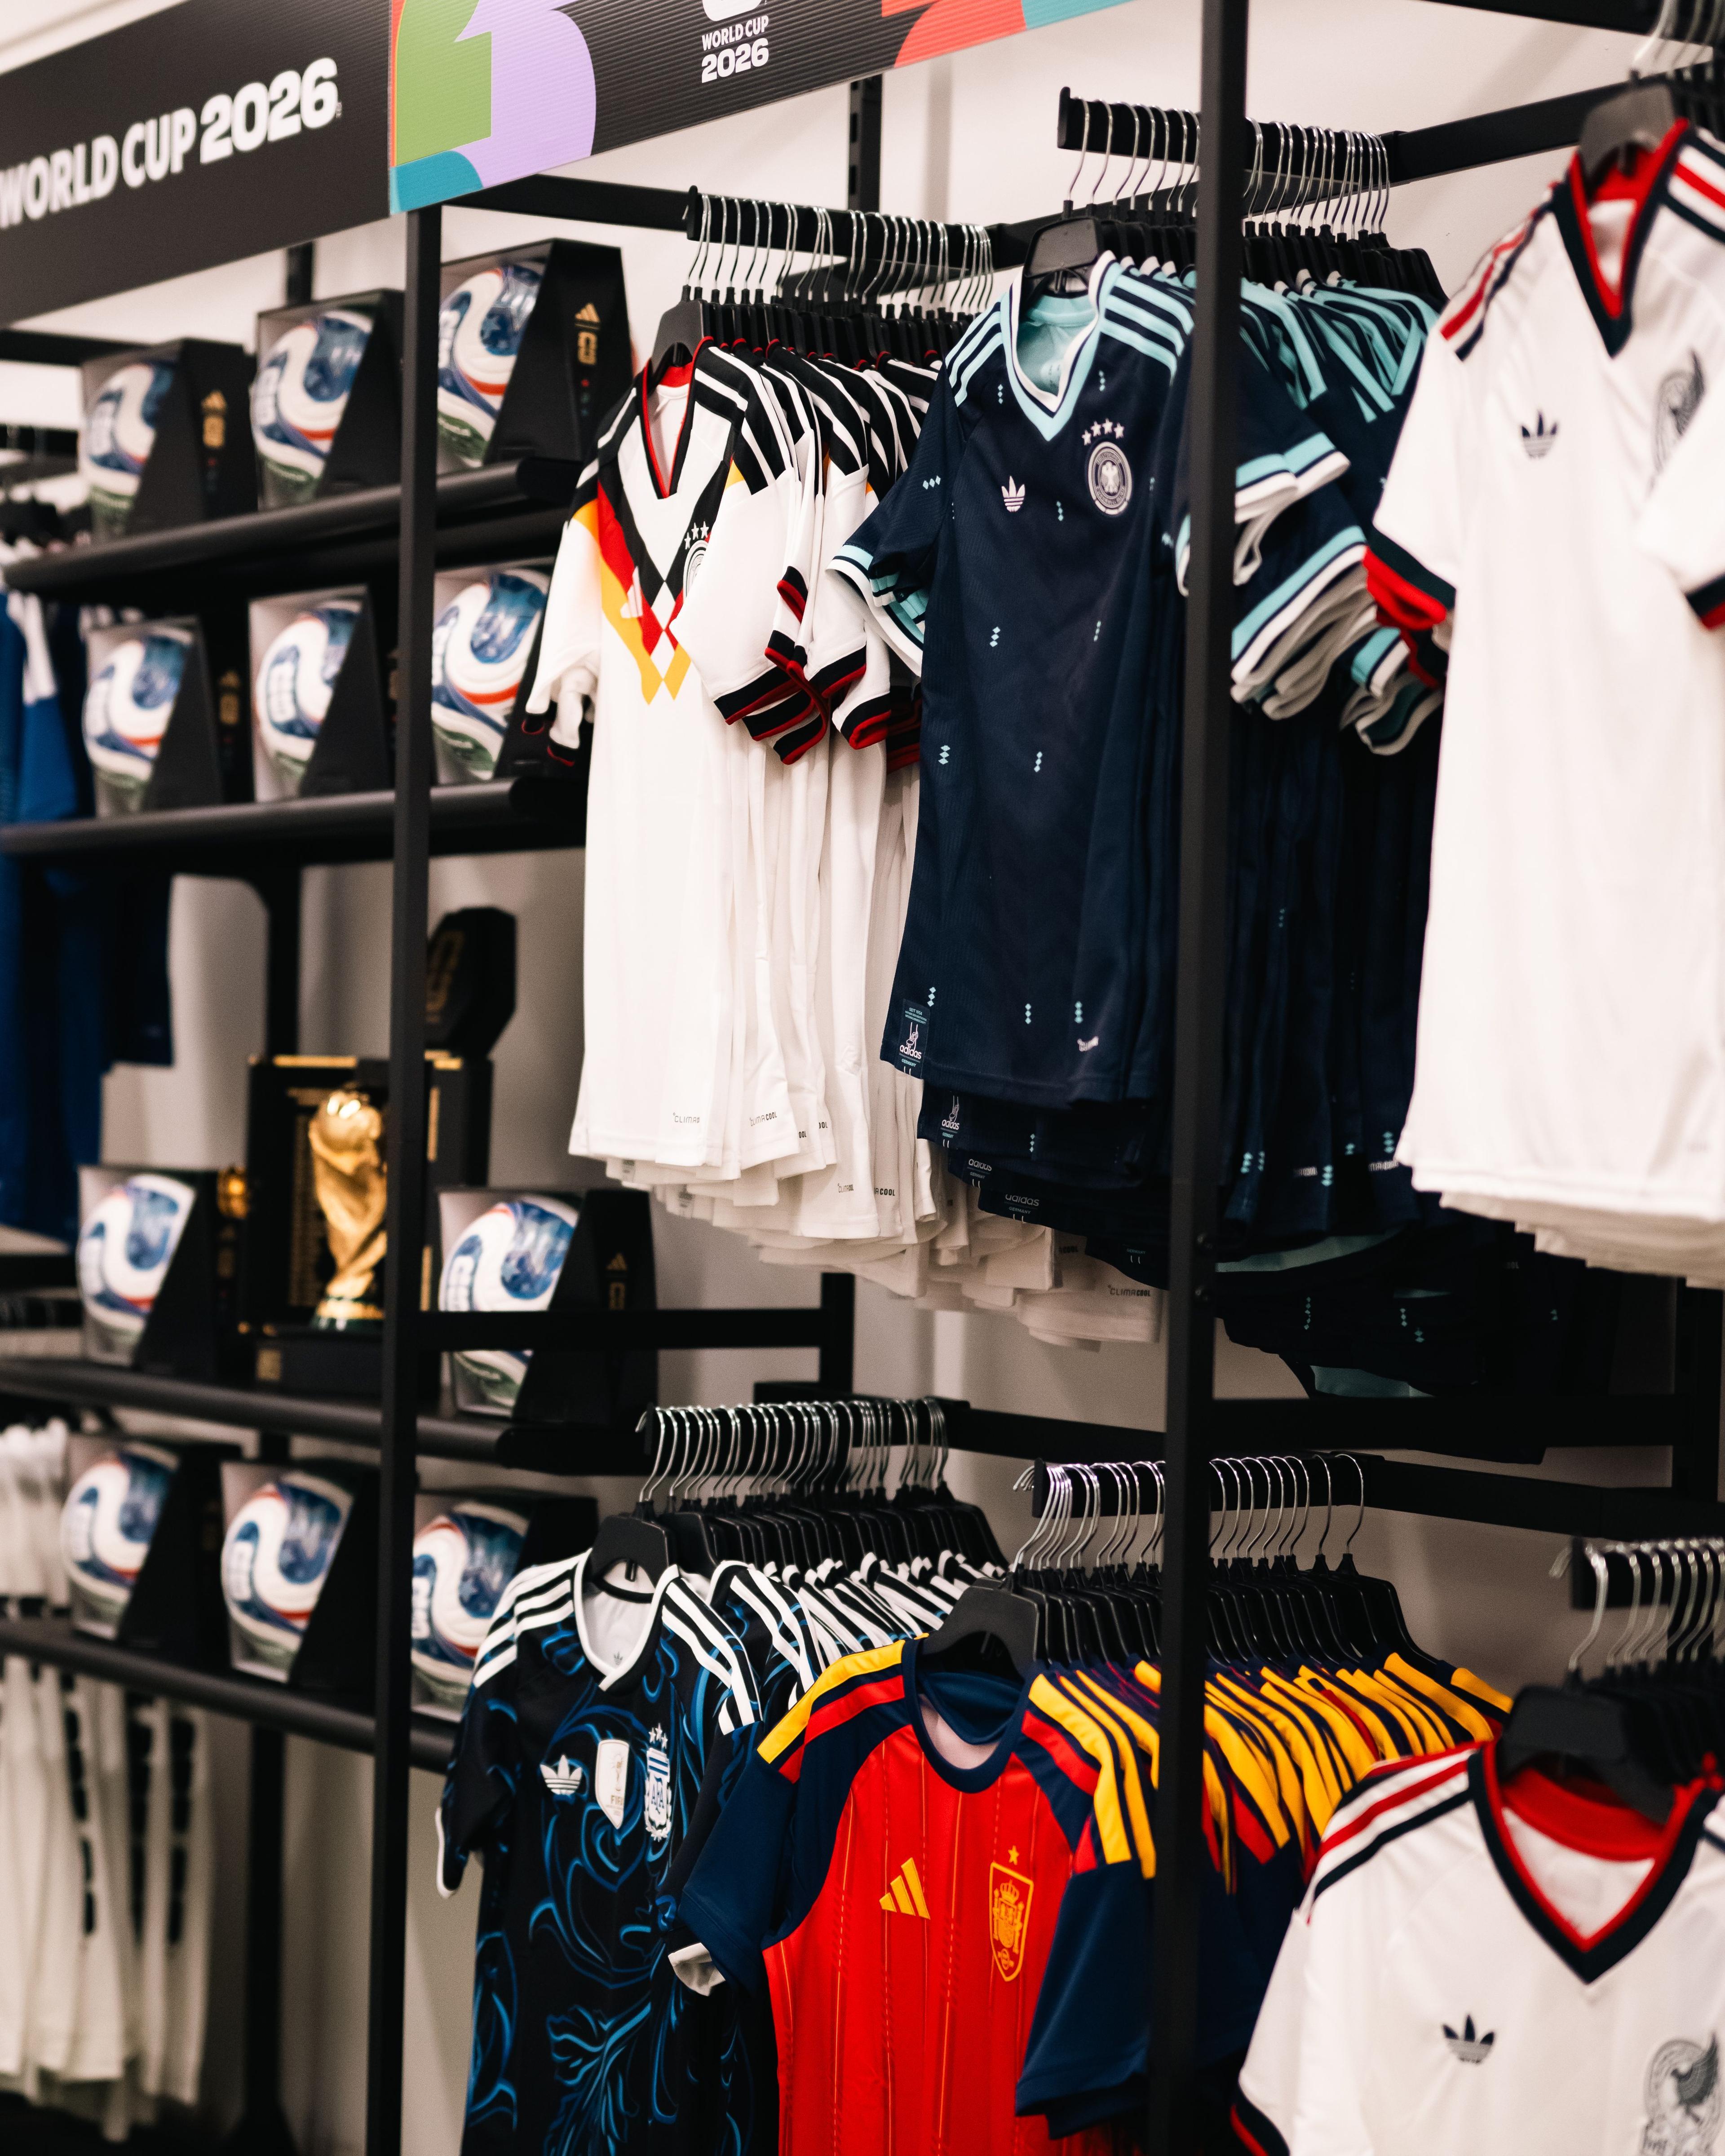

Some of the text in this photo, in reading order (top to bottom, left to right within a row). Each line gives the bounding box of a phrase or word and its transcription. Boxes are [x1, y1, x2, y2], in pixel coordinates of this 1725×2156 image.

[702, 15, 769, 51] WORLD CUP
[702, 38, 769, 83] 2026
[0, 57, 338, 229] WORLD CUP 2026
[900, 1045, 922, 1059] adidas
[902, 1059, 916, 1067] GERMANY
[942, 1119, 960, 1130] adidas
